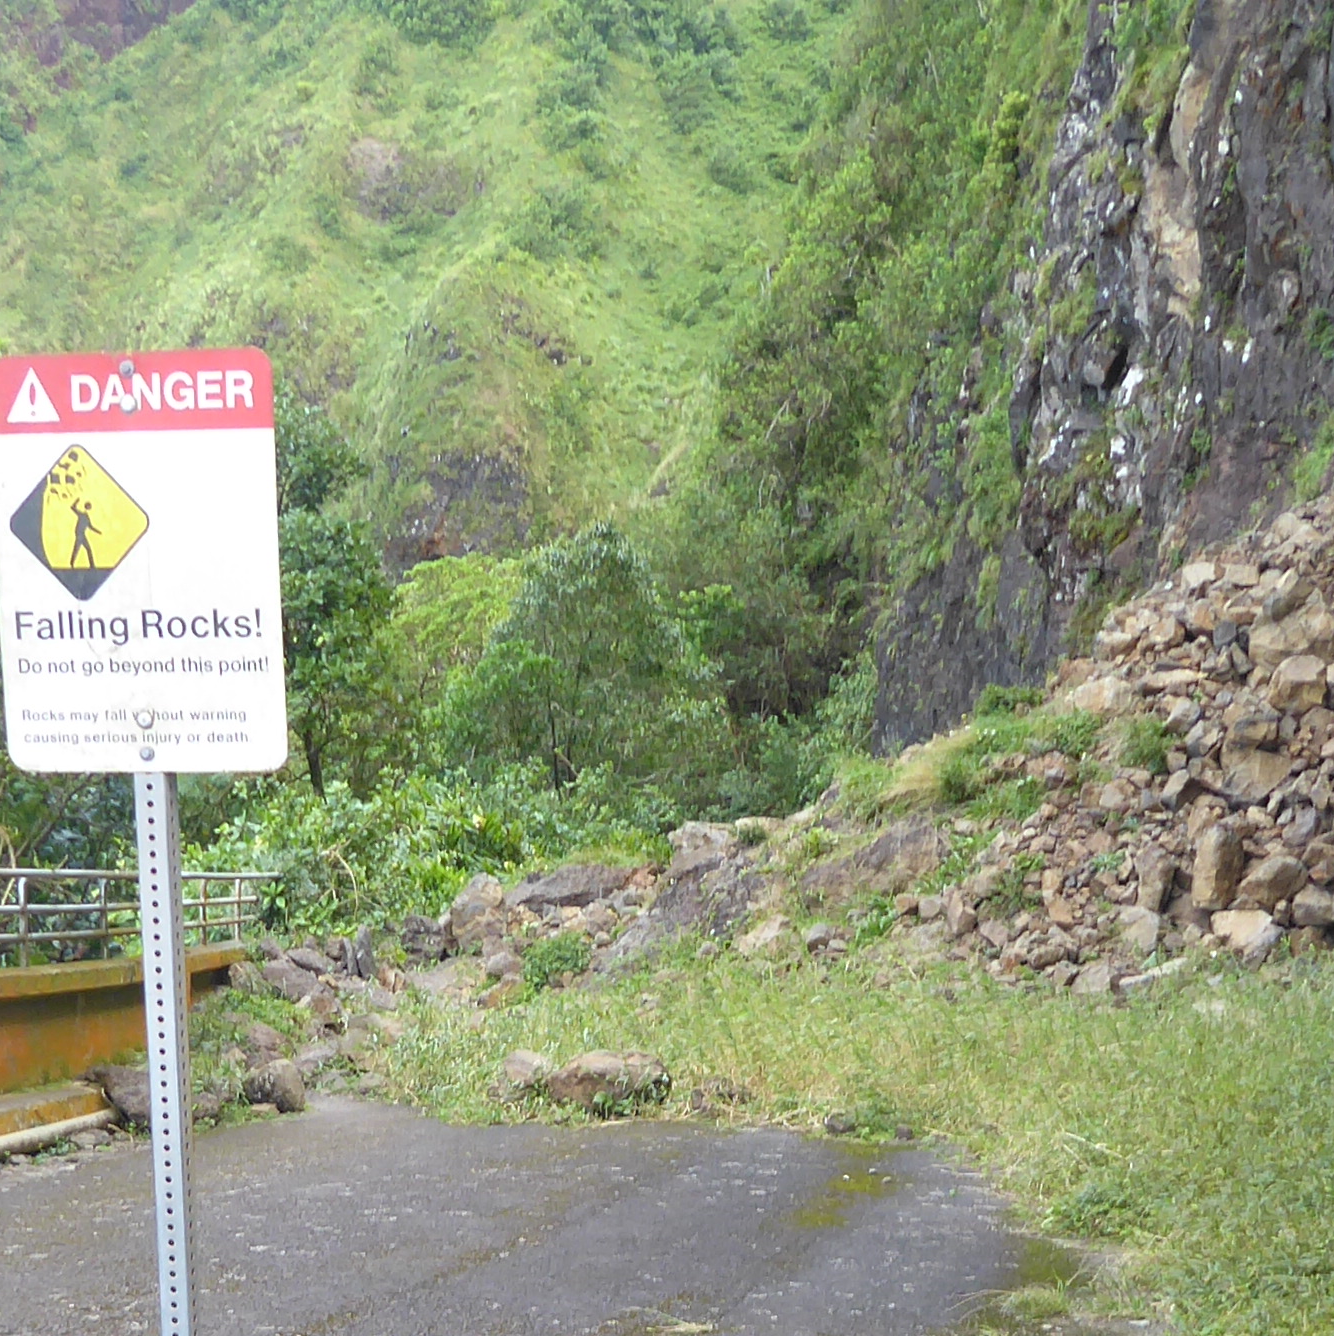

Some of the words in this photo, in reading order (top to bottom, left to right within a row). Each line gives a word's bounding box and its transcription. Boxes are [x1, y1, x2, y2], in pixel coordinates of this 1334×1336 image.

[70, 371, 254, 413] DANGER
[14, 611, 130, 646] Falling
[141, 609, 262, 639] Rocks!
[18, 658, 42, 674] Do
[48, 658, 75, 674] not
[82, 660, 104, 676] go
[110, 657, 175, 677] beyond
[181, 657, 213, 673] this
[219, 656, 269, 676] point!
[22, 709, 65, 721] Rocks
[70, 710, 98, 723] may
[104, 708, 127, 721] fall
[132, 708, 184, 721] whout
[190, 708, 247, 723] warning
[24, 731, 79, 744] causing
[84, 731, 137, 743] serious
[142, 731, 181, 745] injury
[187, 733, 201, 743] or
